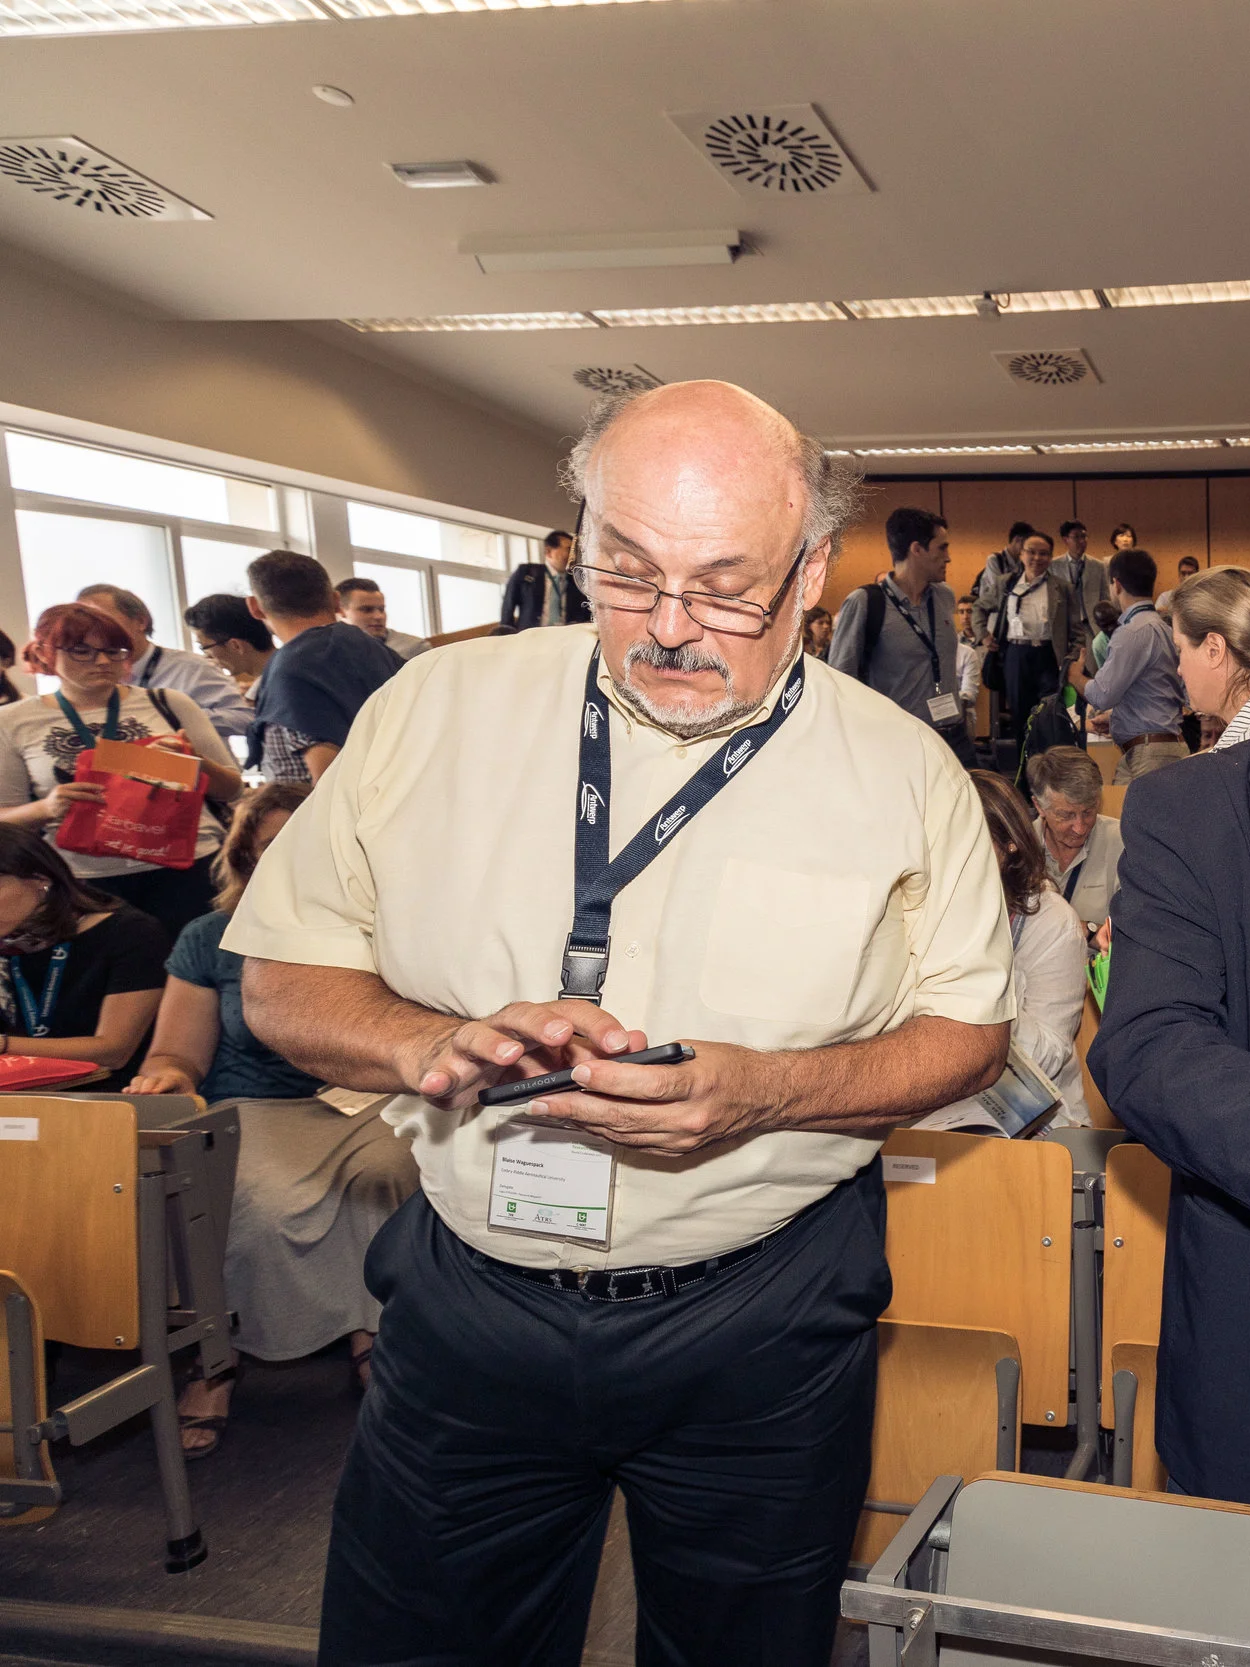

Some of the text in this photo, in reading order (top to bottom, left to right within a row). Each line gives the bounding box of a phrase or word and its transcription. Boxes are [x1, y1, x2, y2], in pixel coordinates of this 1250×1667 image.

[590, 711, 598, 740] Antwerp
[727, 739, 752, 765] Antwerp
[588, 793, 598, 825] Antwerp
[659, 805, 686, 831] Antwerp
[513, 1075, 557, 1092] ADOPTED
